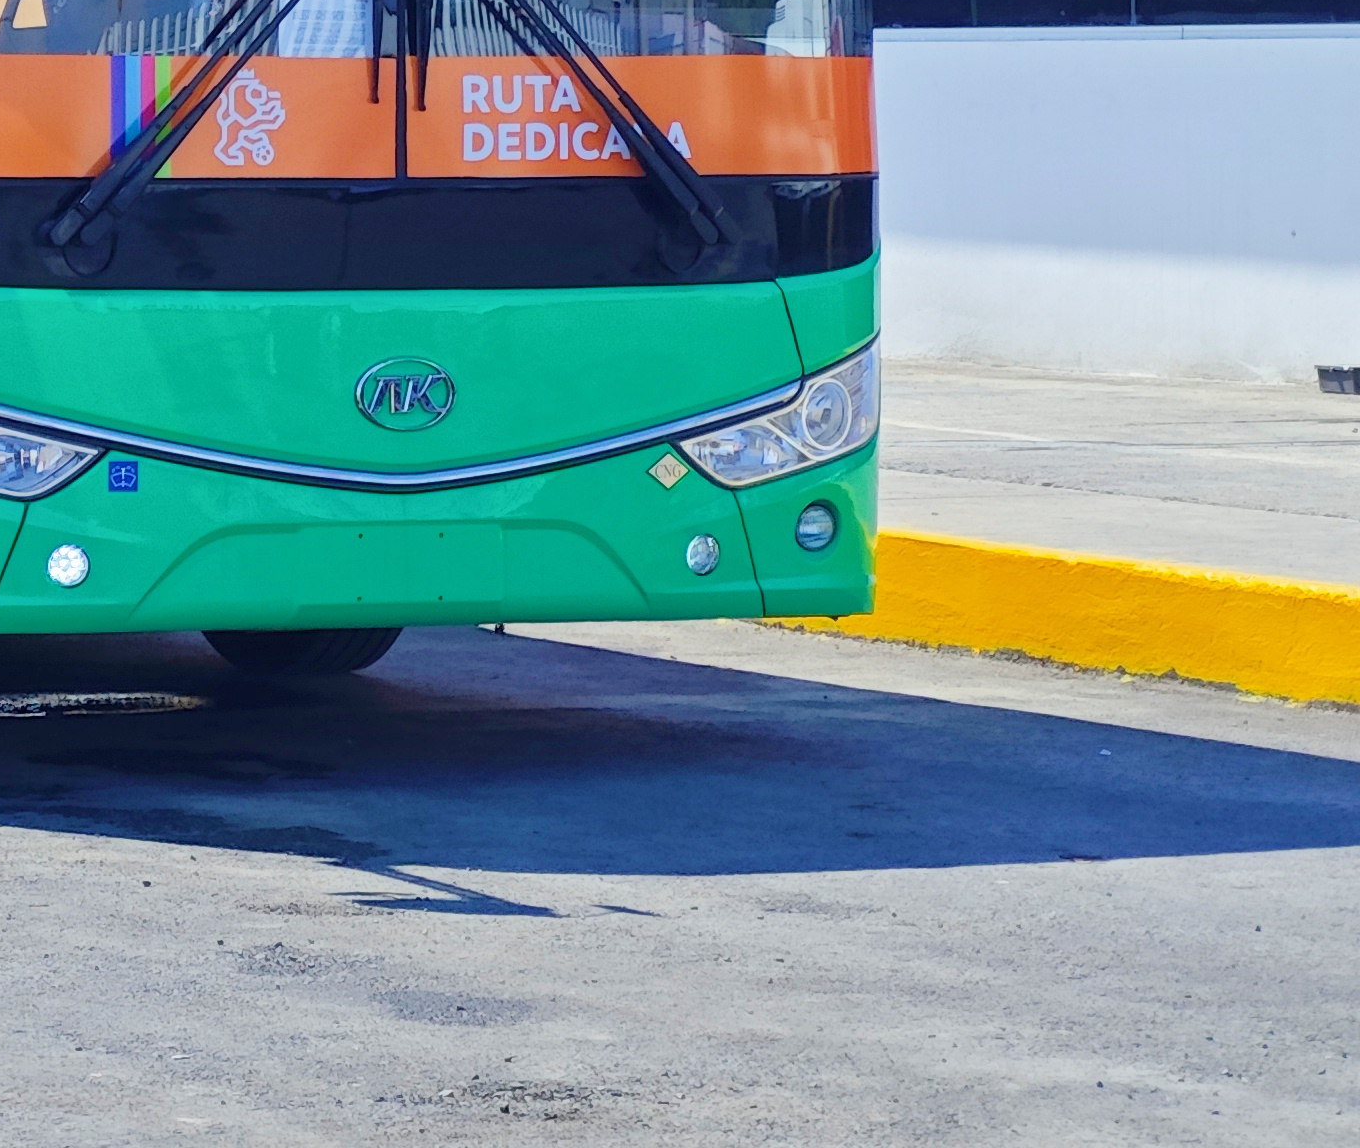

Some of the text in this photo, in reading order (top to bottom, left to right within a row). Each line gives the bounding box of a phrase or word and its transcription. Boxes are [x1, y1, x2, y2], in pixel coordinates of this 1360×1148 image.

[462, 75, 581, 113] RUTA
[462, 120, 692, 161] DEDICAA
[654, 464, 681, 479] CNG
